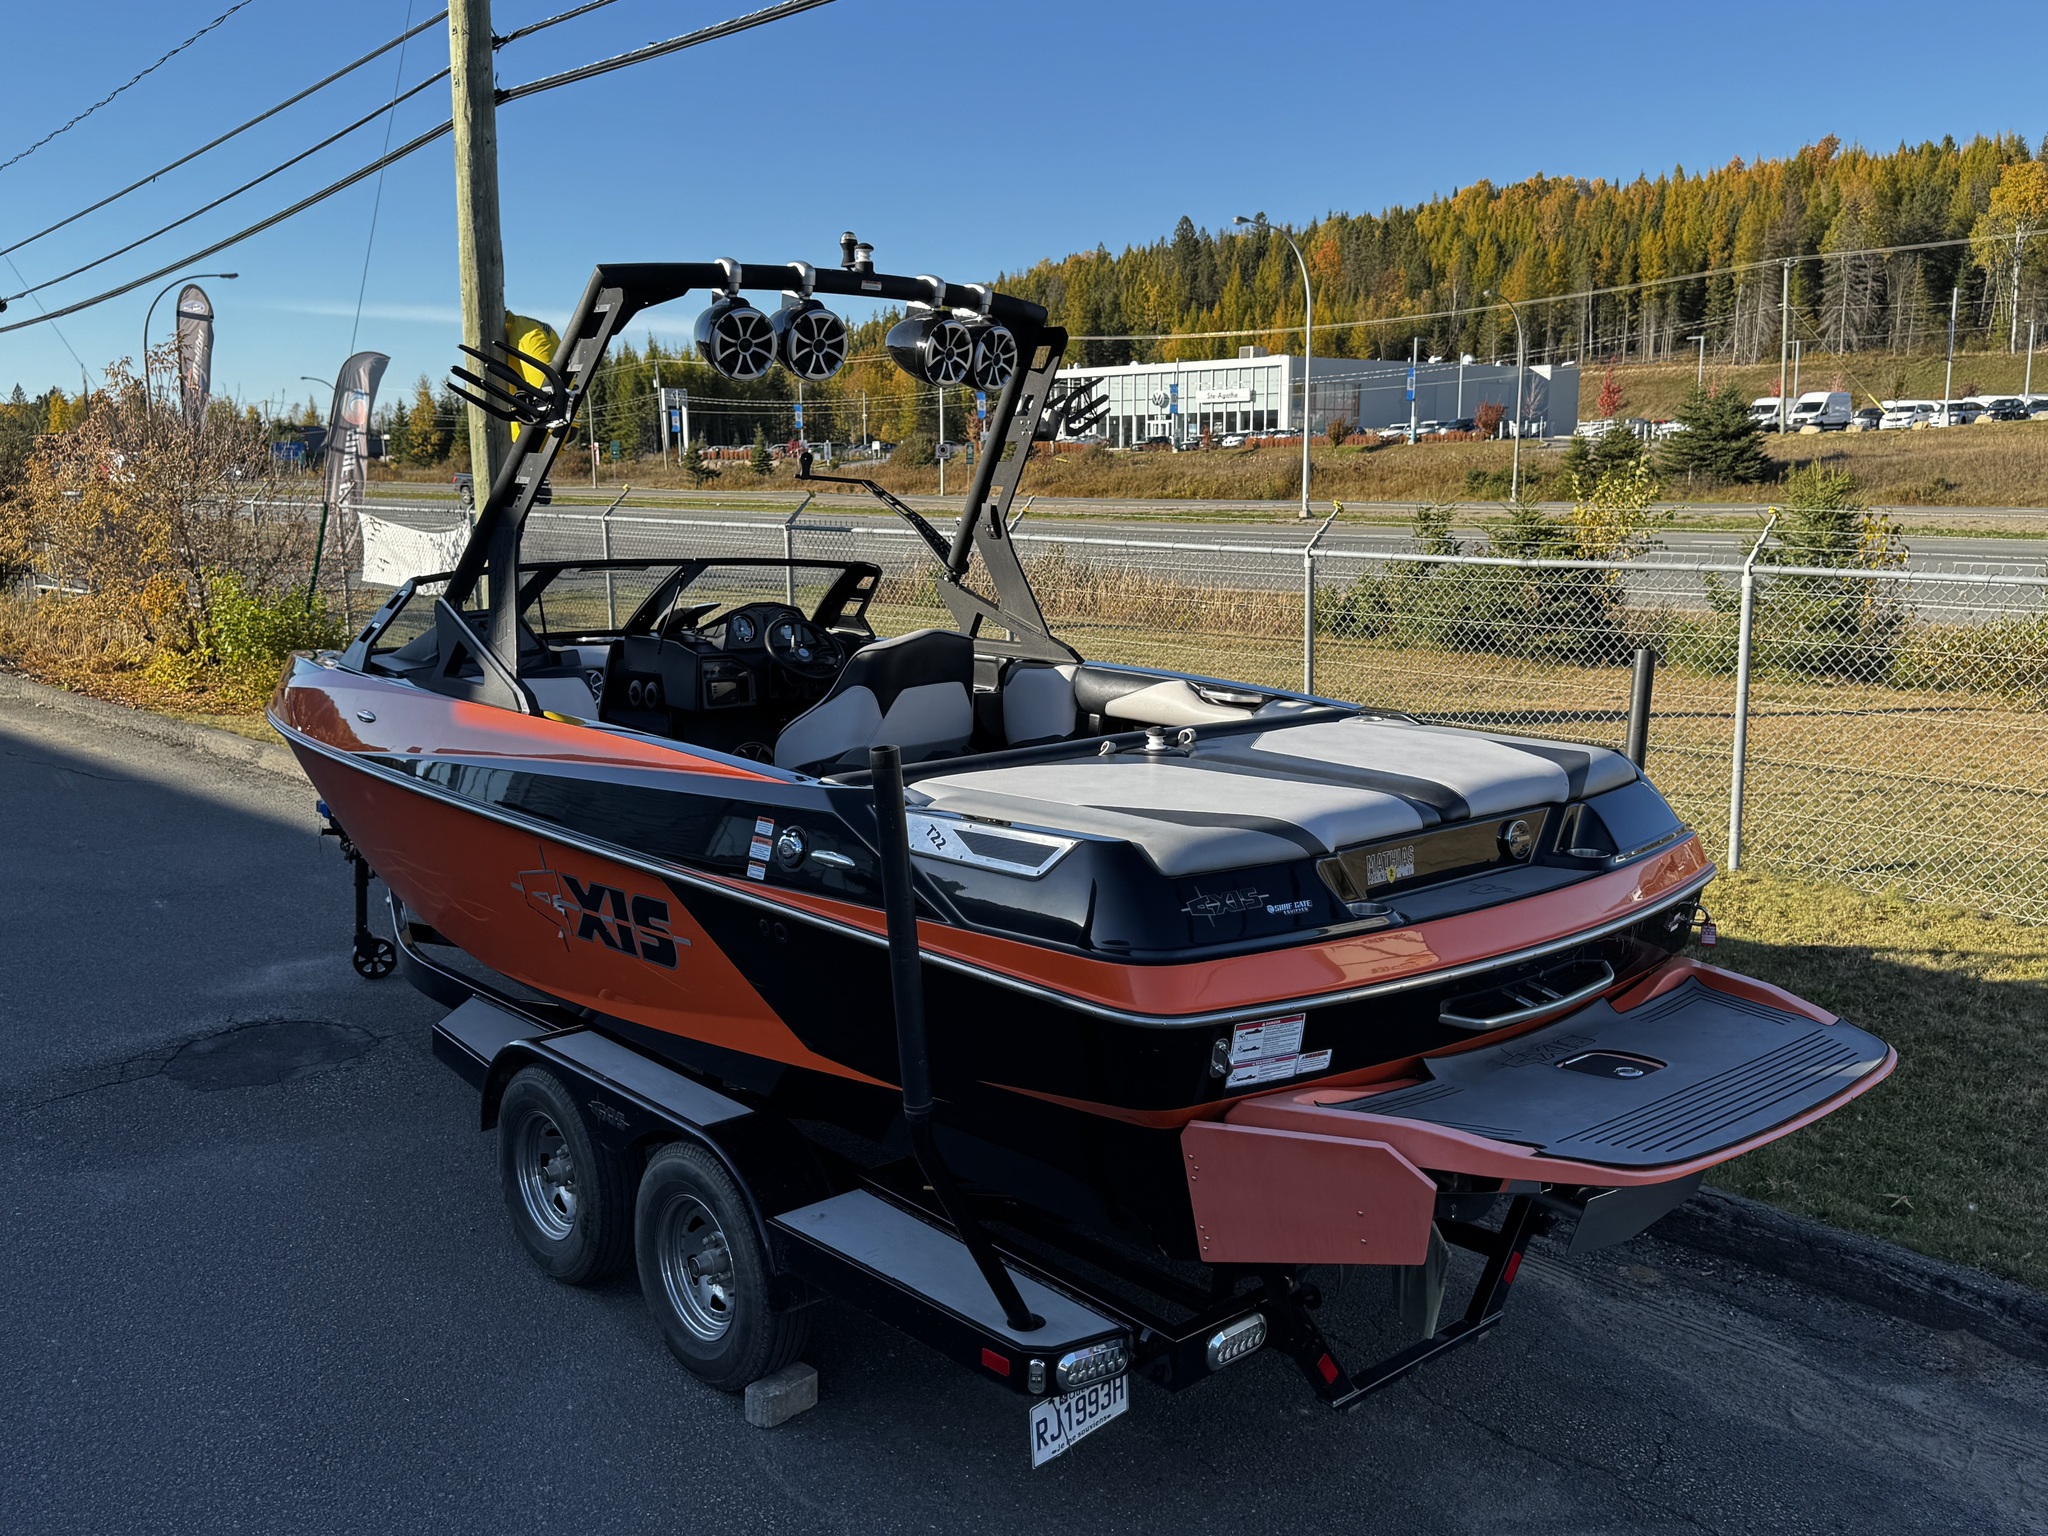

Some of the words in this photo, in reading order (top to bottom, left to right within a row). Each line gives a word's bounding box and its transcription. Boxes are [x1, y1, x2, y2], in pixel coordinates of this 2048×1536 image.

[925, 824, 947, 851] T22
[1366, 845, 1415, 873] MATHIAS
[1294, 900, 1313, 909] GATE
